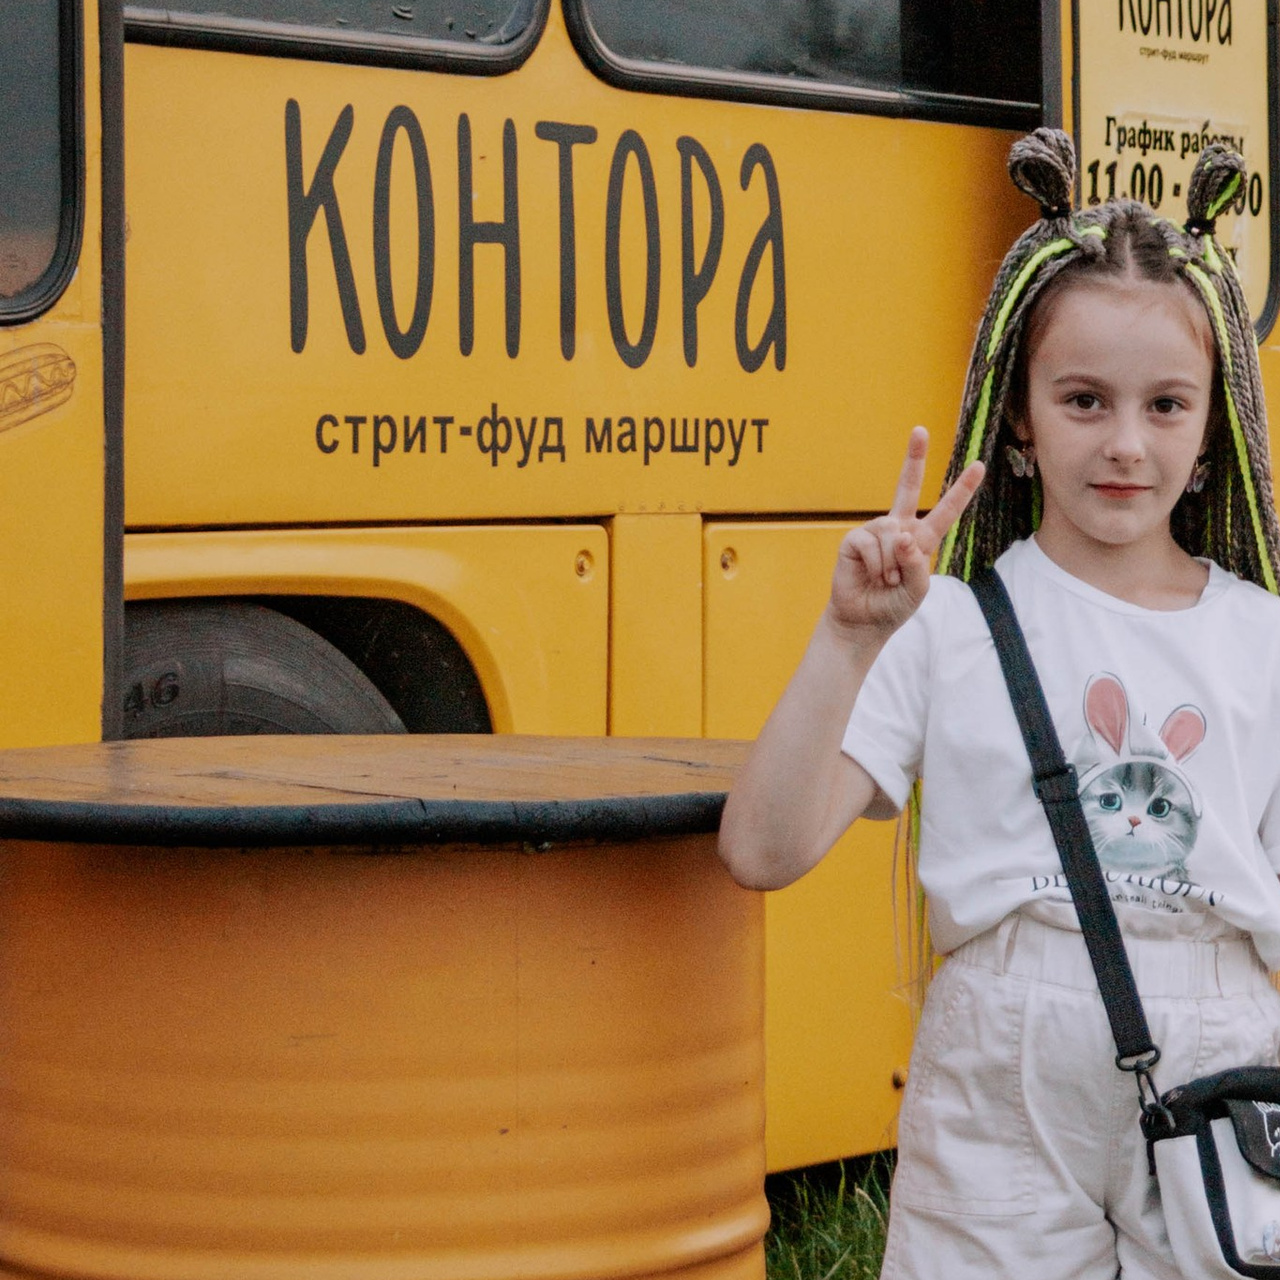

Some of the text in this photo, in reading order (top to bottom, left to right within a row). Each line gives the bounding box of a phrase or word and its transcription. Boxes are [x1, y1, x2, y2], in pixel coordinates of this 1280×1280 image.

[1105, 116, 1175, 157] График
[315, 403, 769, 468] стрит-фуд маршрут
